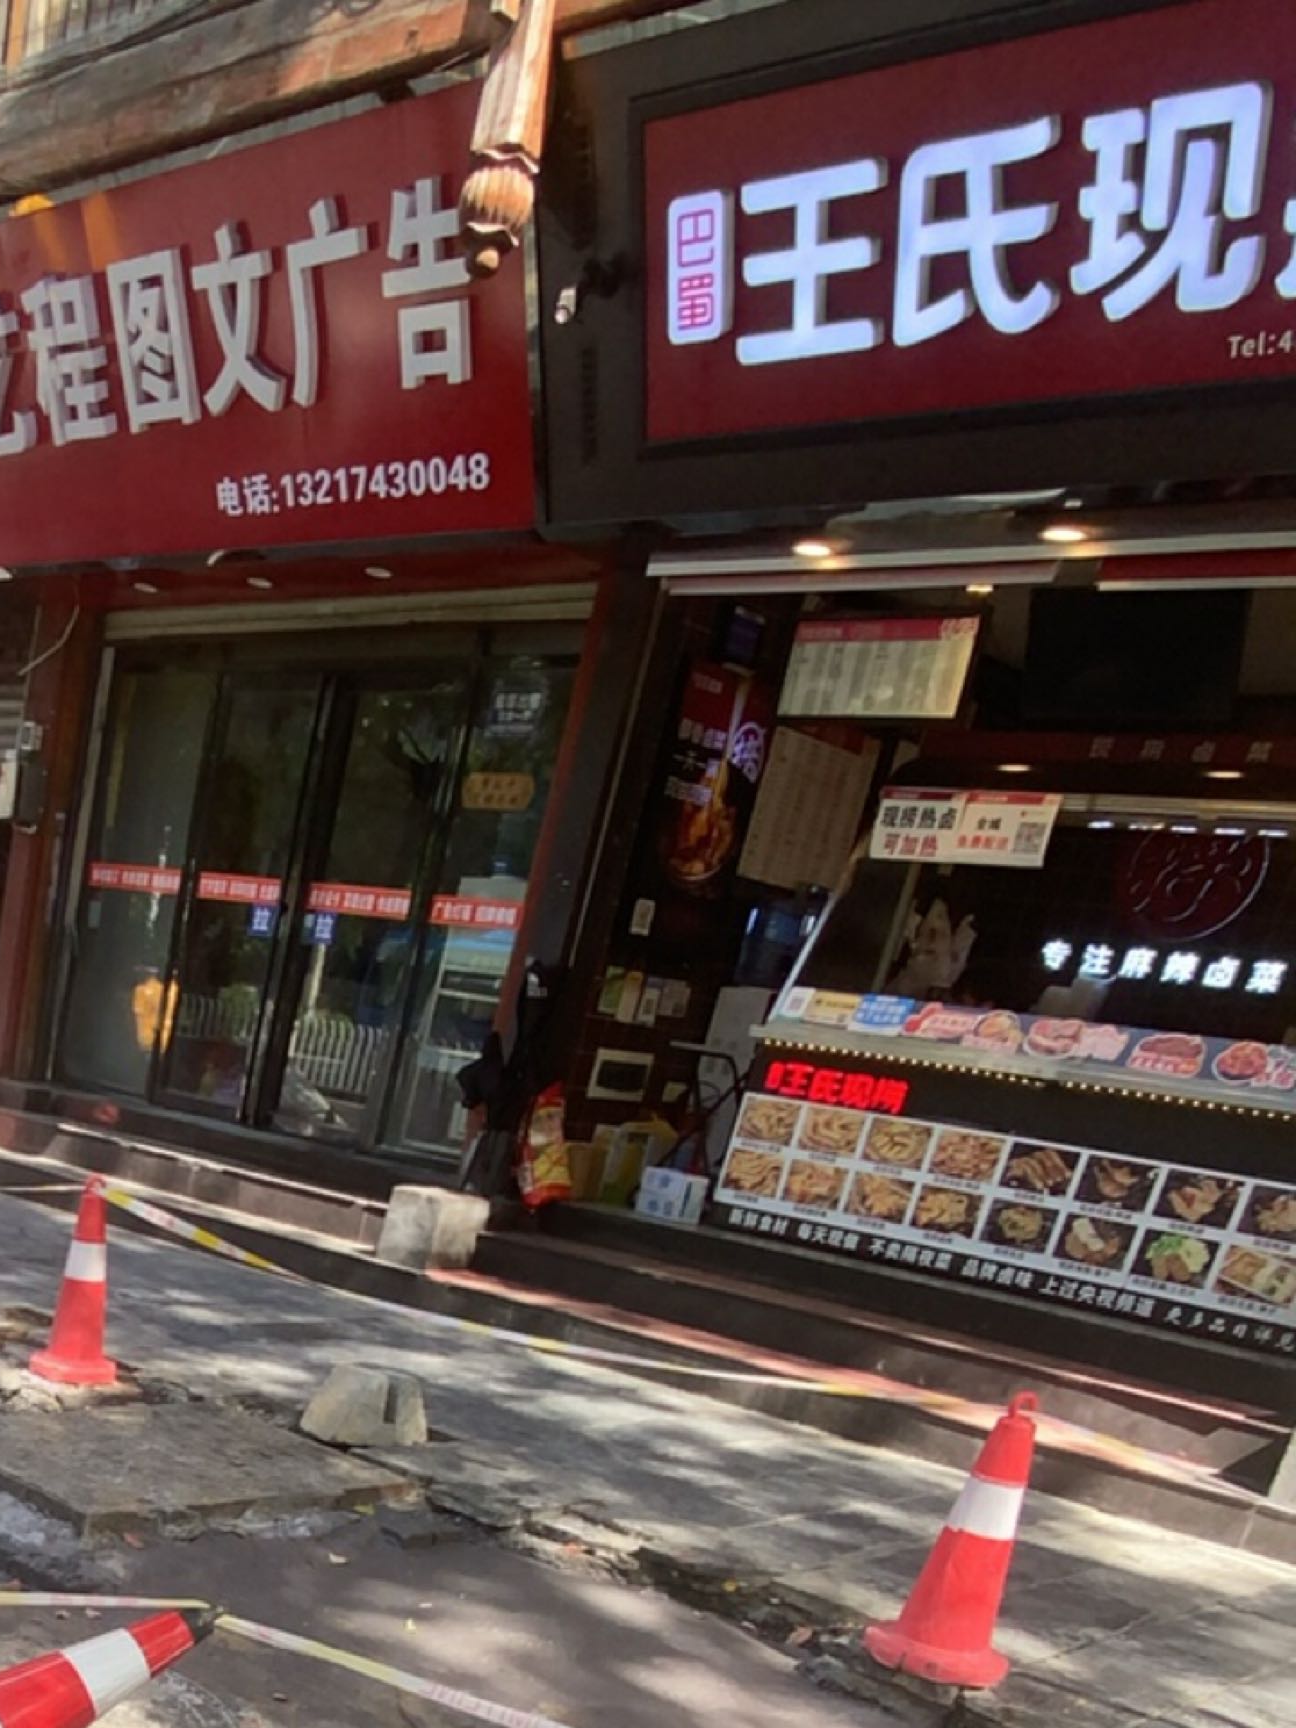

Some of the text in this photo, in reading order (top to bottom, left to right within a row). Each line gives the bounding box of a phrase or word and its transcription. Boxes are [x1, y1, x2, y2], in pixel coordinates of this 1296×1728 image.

[735, 82, 1296, 366] 王氏现
[215, 453, 491, 517] 电话:13217430048
[1041, 937, 1288, 995] 专注麻辣卤菜
